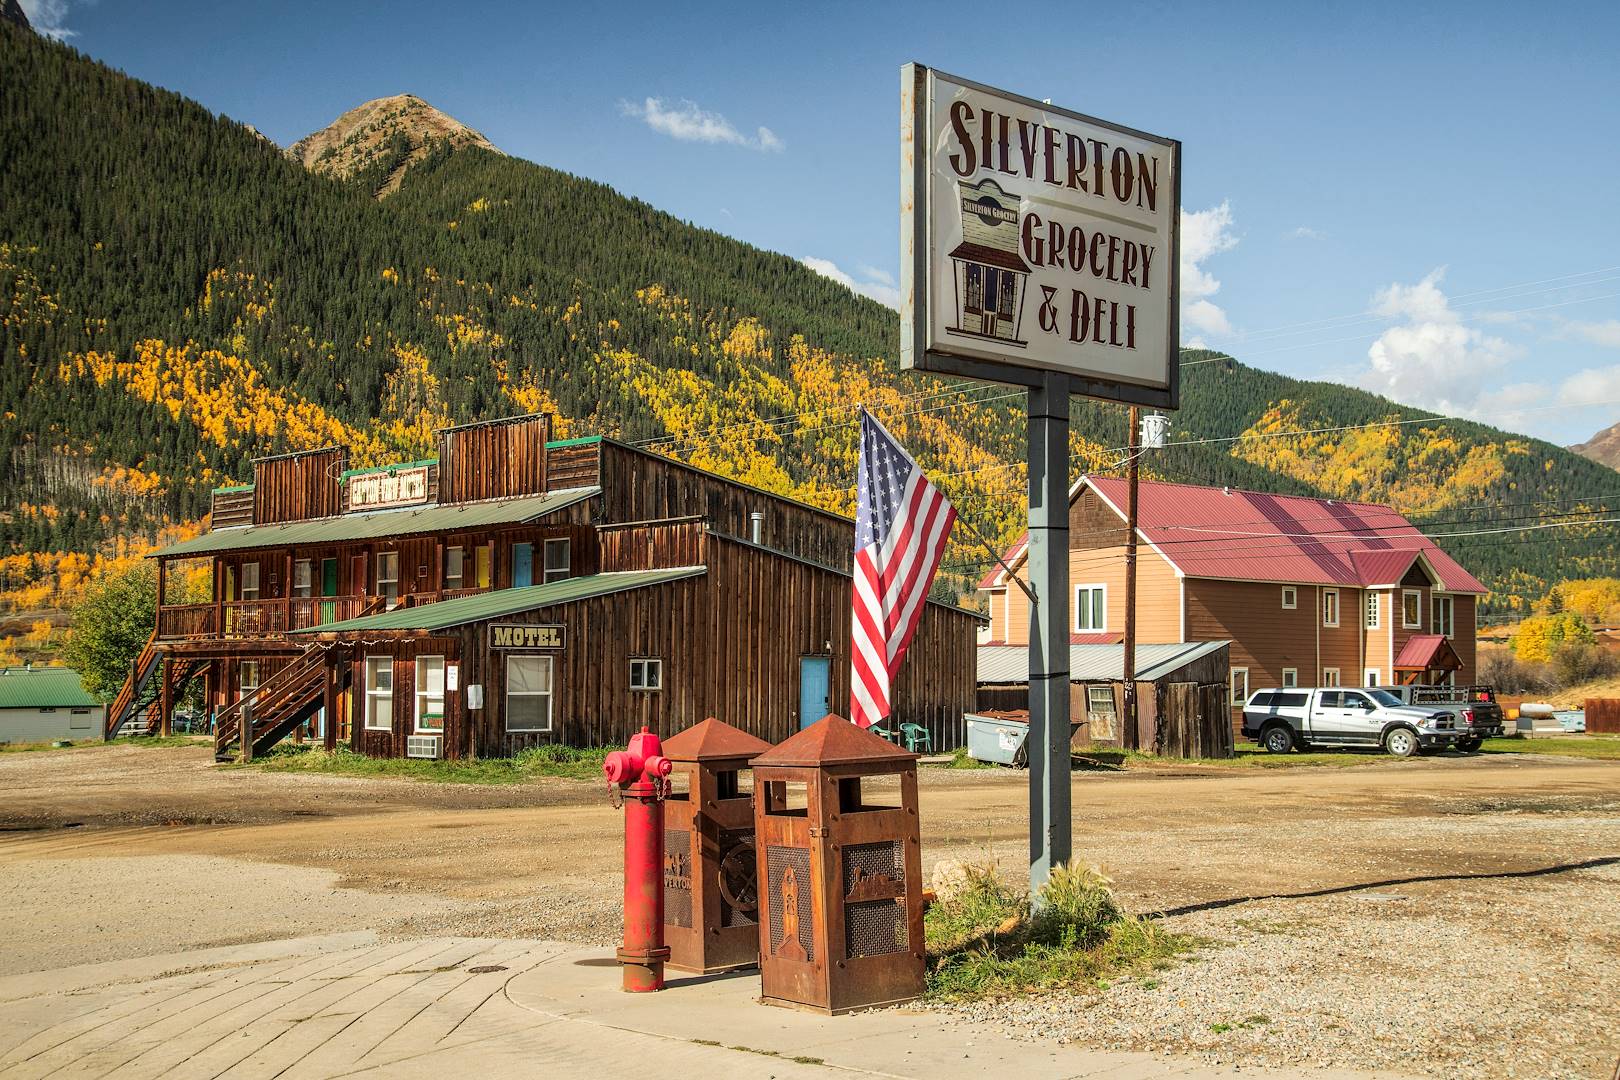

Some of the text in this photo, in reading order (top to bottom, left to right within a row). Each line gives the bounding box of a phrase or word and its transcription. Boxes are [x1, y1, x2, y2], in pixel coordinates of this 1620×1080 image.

[949, 101, 1159, 212] SILVERTON
[1022, 212, 1155, 288] GROCERY
[1038, 284, 1137, 349] & DELI
[494, 627, 561, 647] MOTEL
